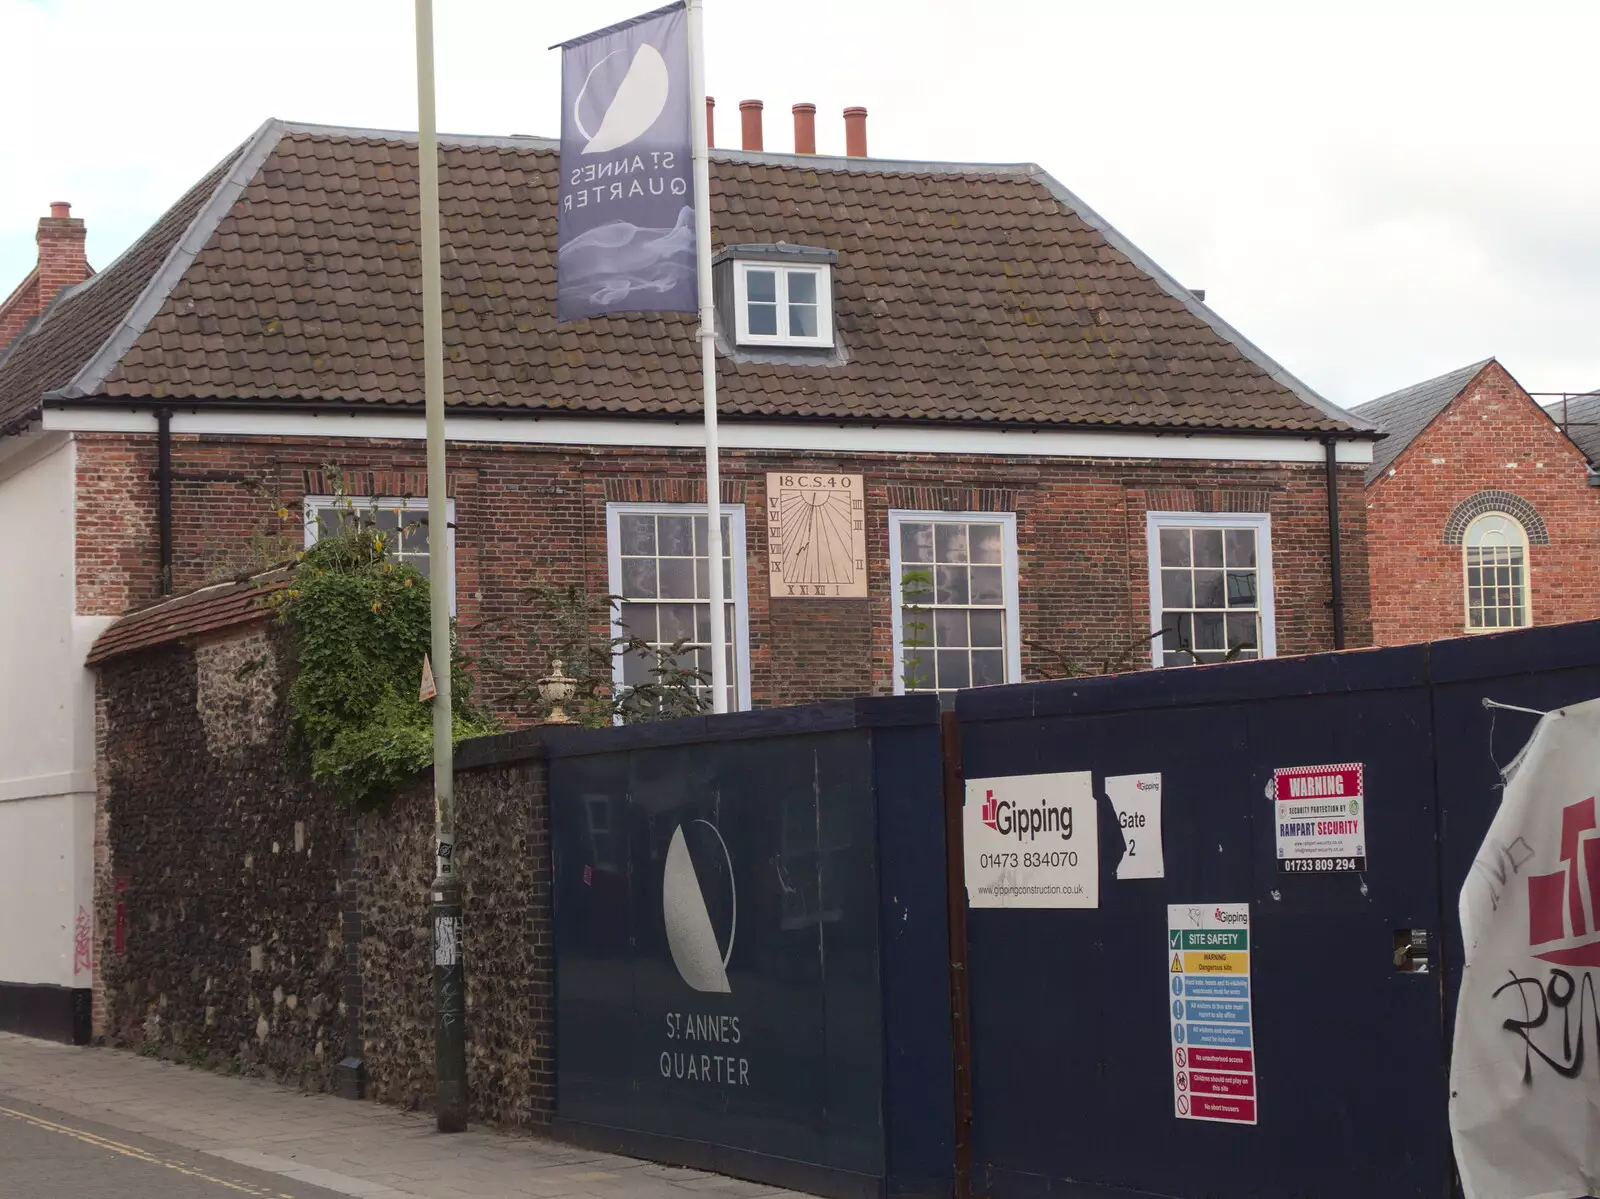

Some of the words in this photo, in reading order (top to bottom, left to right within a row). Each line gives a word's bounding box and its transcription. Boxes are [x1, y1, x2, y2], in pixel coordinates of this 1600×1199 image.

[1288, 774, 1344, 798] WARNING
[1289, 806, 1310, 815] SECURITY
[1310, 805, 1339, 814] PROTECTION
[996, 798, 1073, 841] Gipping
[1119, 812, 1146, 829] Gate
[1280, 822, 1315, 837] RAMPART
[1317, 820, 1358, 836] SECURITY
[1128, 839, 1136, 856] 2
[980, 853, 1019, 868] 01473
[1023, 851, 1078, 868] 834070
[1285, 860, 1313, 872] 01733
[1315, 859, 1334, 871] 809
[1336, 858, 1356, 870] 294
[978, 884, 1084, 896] www.gippingconstruction.co.uk
[1220, 912, 1248, 924] Gipping
[1189, 934, 1205, 945] SITE
[1207, 934, 1238, 945] SAFETY
[1199, 964, 1222, 972] Dangerous
[685, 1013, 740, 1044] ANNE'S
[660, 1051, 749, 1086] QUARTER
